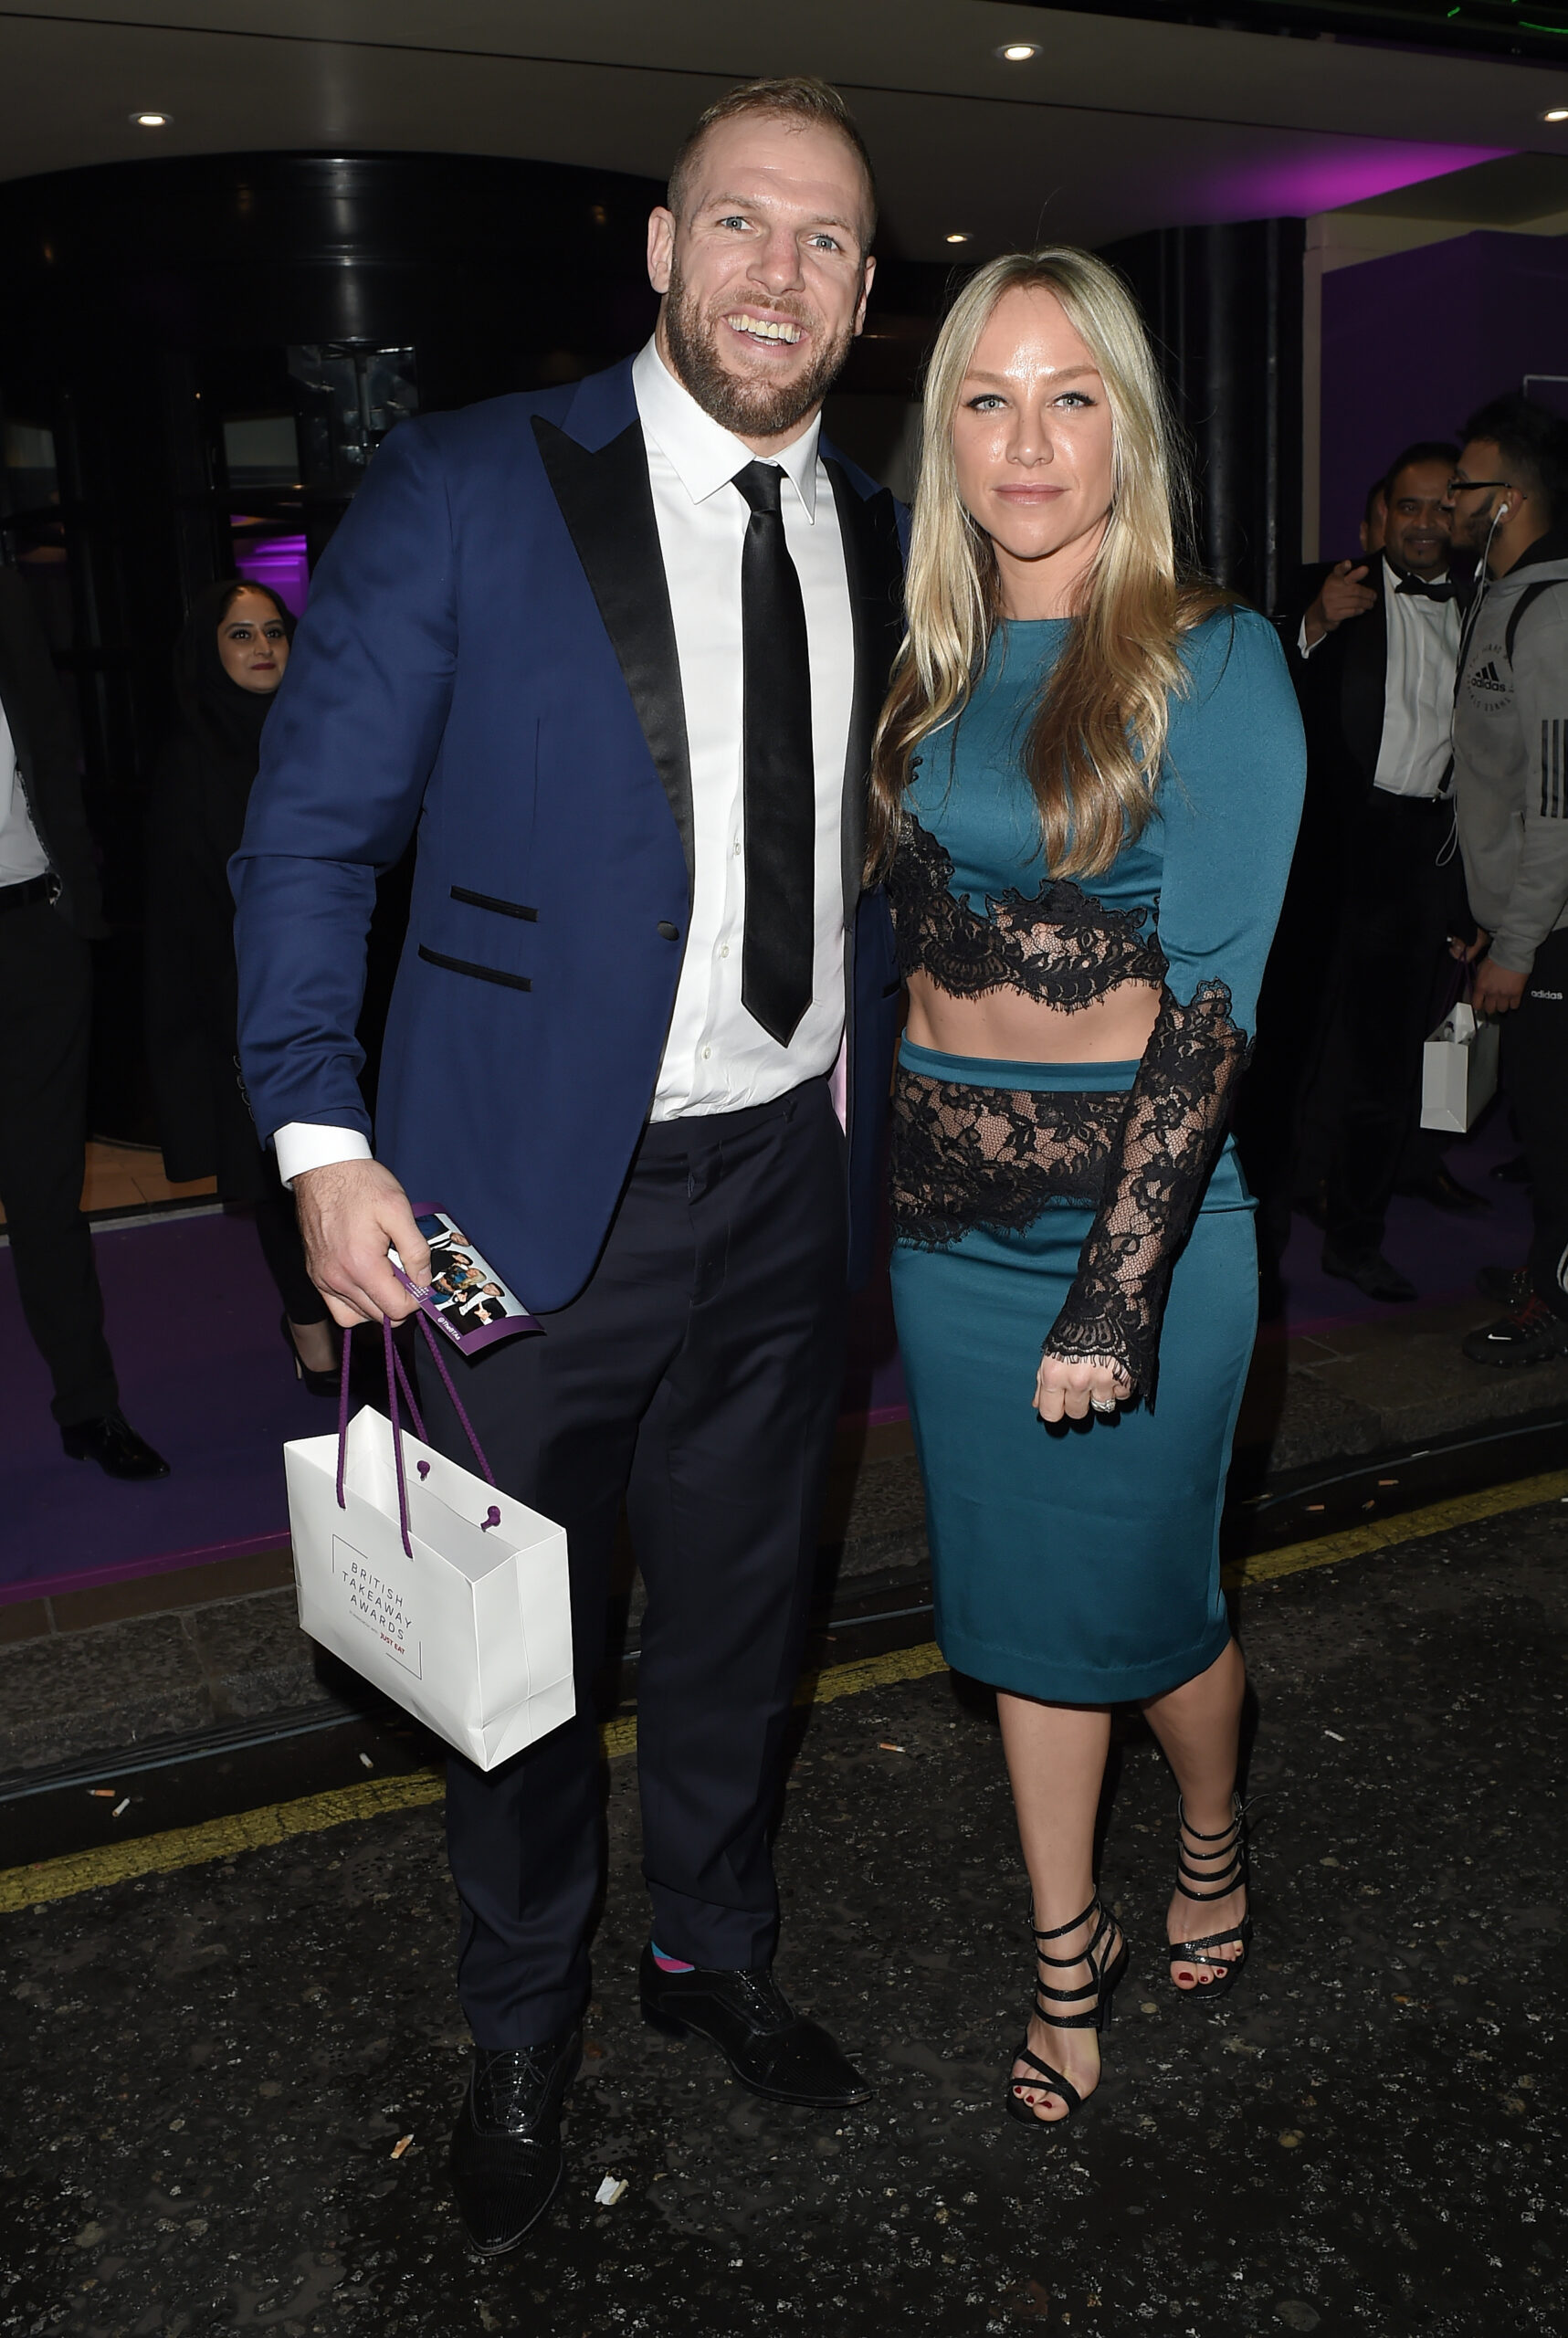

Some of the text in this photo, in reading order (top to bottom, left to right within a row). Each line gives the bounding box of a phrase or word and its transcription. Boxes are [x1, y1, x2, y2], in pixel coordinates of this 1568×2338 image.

[1471, 678, 1506, 692] adidas
[1531, 989, 1563, 1000] adidas
[342, 1571, 412, 1628] TAKEAWAY
[351, 1562, 403, 1607] BRITISH
[350, 1594, 404, 1640] AWARDS
[380, 1632, 405, 1655] JUST EAT
